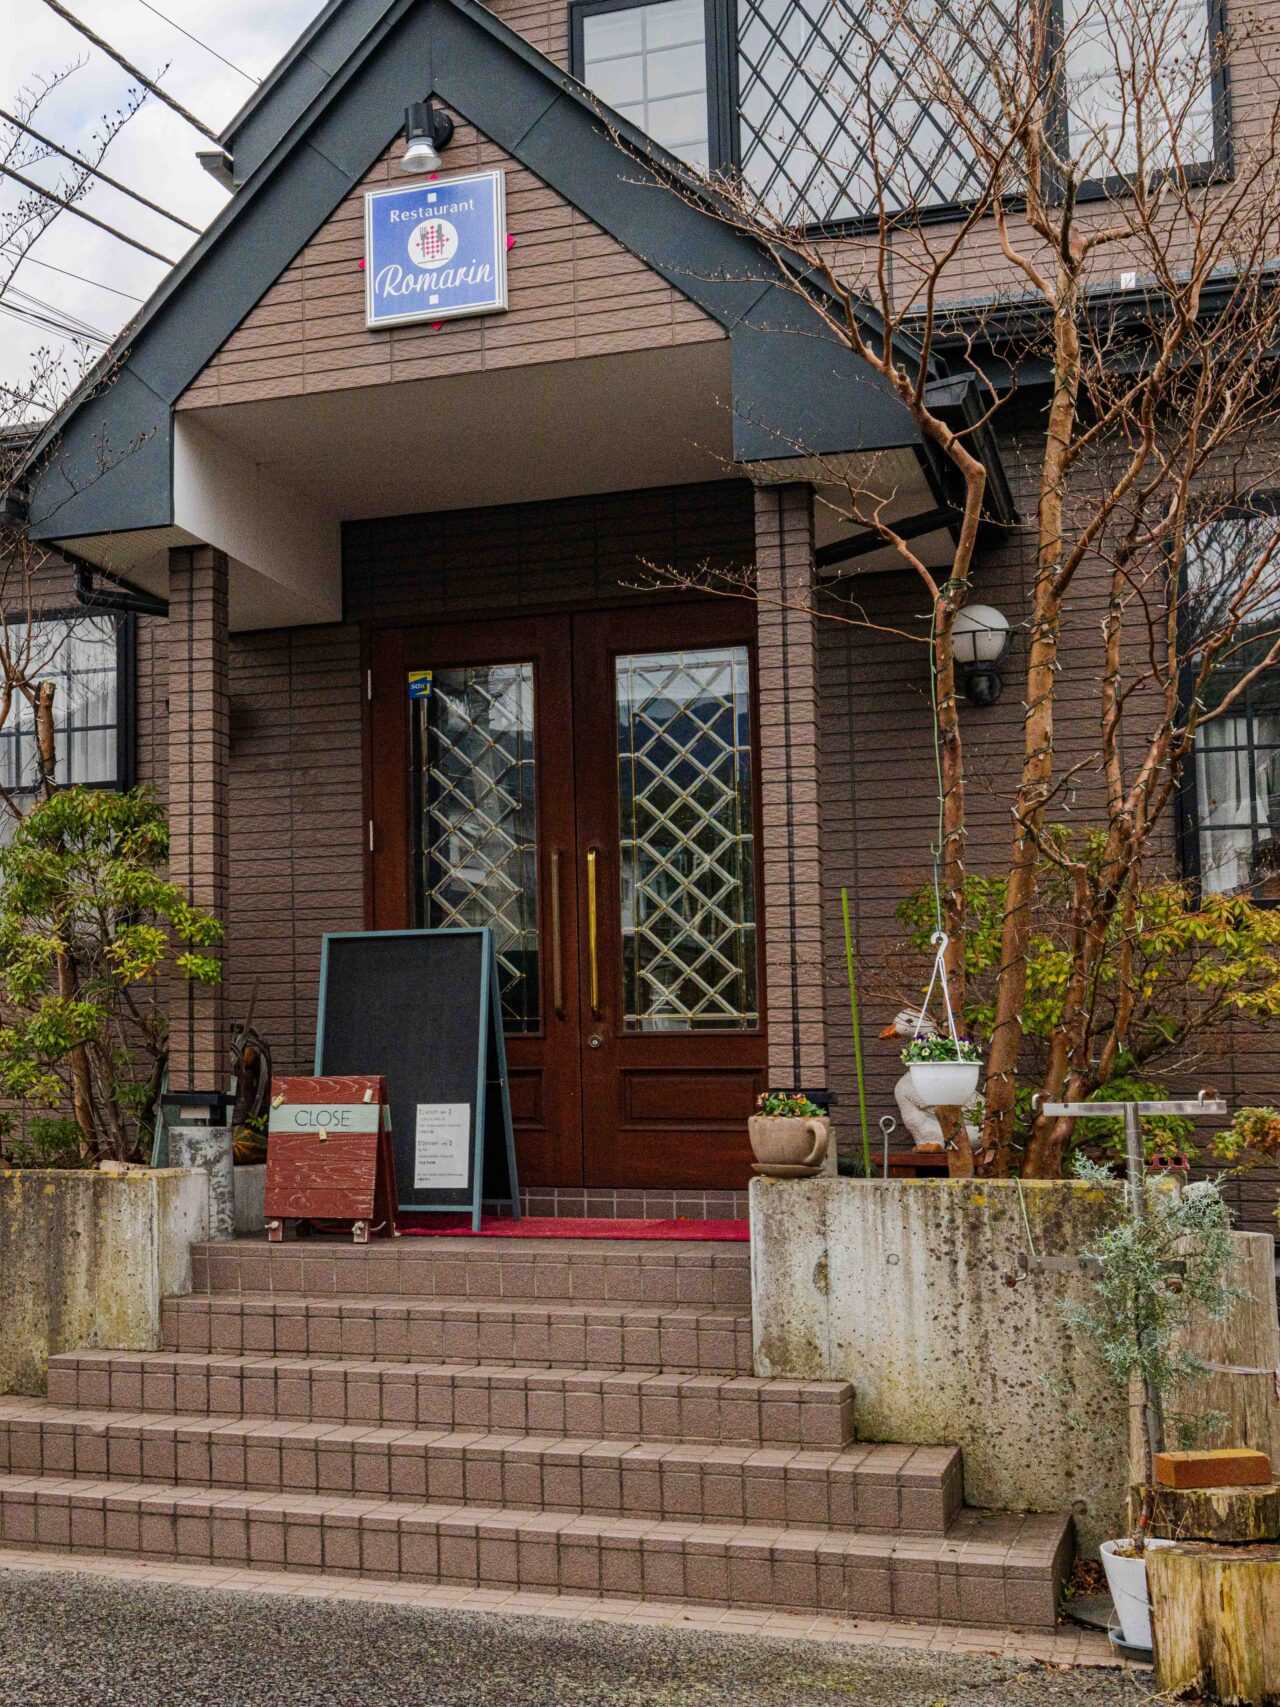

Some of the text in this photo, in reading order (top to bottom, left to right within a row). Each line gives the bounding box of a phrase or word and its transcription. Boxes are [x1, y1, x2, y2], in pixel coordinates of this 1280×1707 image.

[390, 199, 475, 223] Restaurant
[375, 259, 494, 299] Romarin
[294, 1110, 353, 1127] CLOSE
